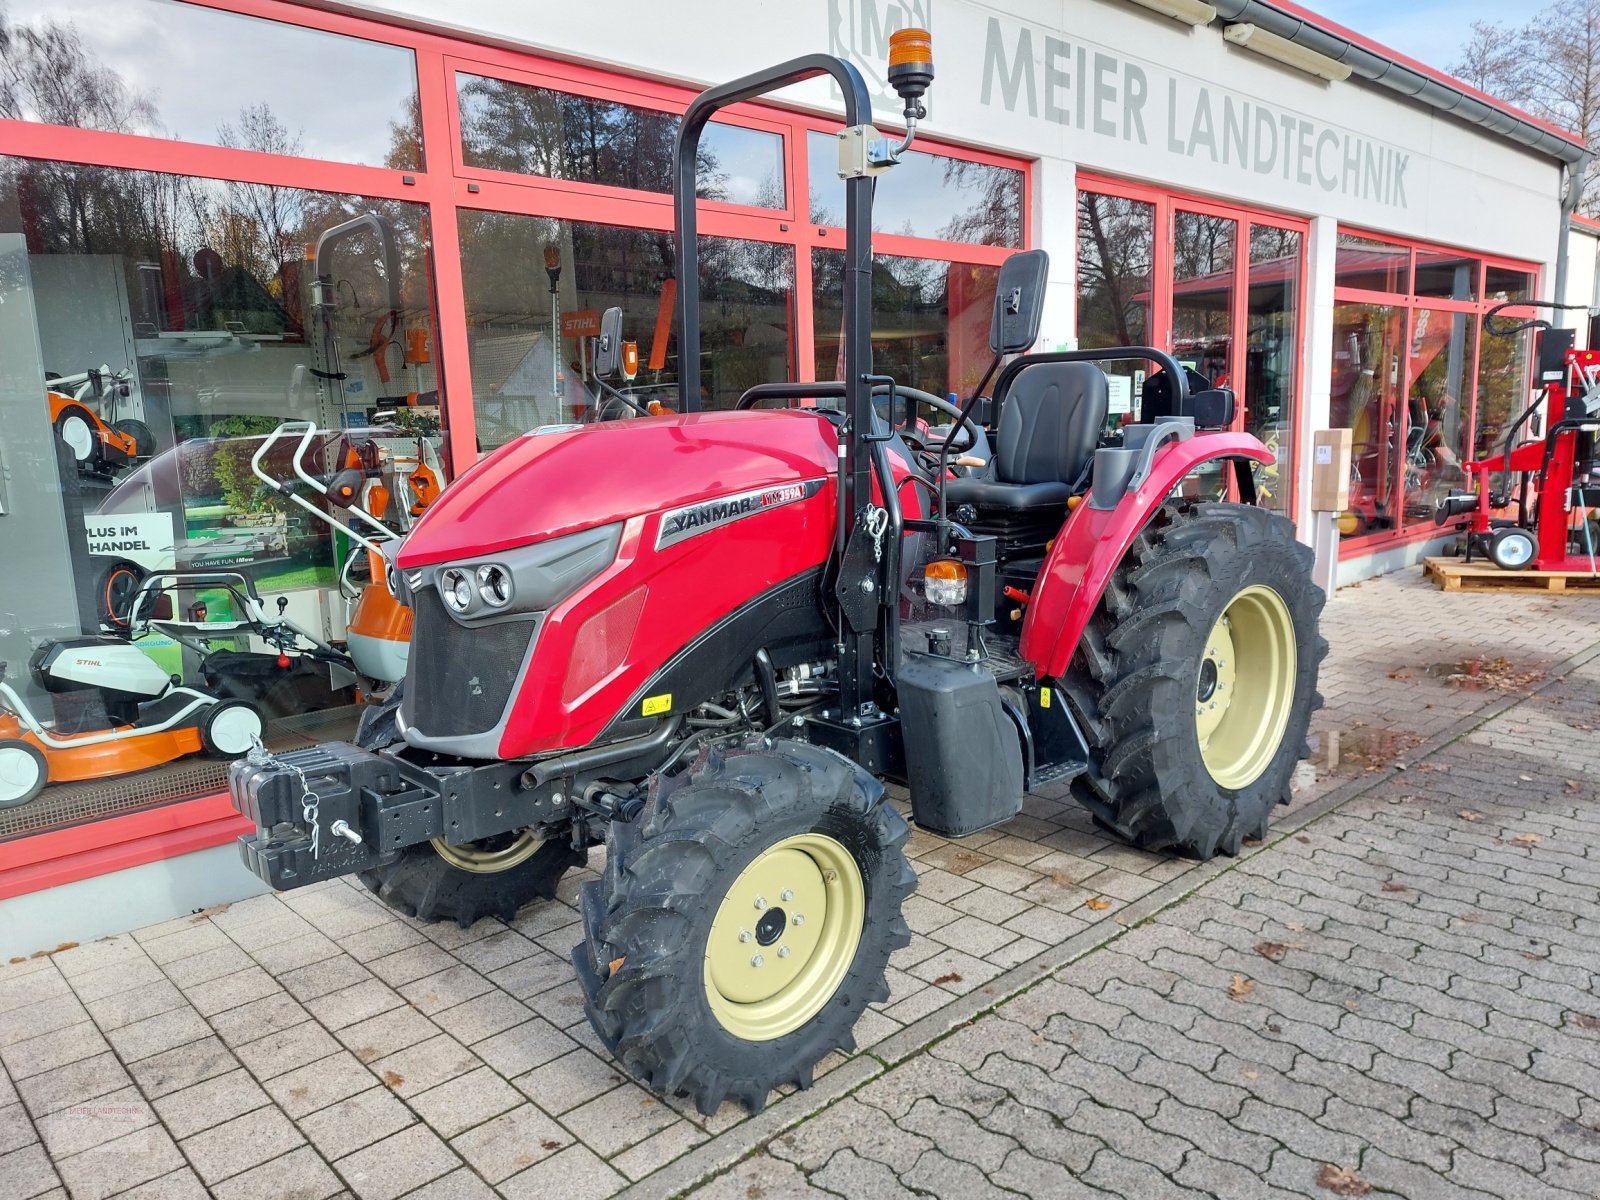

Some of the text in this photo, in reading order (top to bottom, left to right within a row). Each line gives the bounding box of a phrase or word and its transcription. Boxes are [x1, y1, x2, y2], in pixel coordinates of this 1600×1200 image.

[980, 16, 1410, 208] MEIER LANDTECHNIK
[564, 318, 596, 330] STIHL
[673, 497, 752, 532] YANMAR
[86, 526, 138, 538] LUS IM
[89, 540, 151, 552] HANDEL
[76, 659, 102, 667] STIHL
